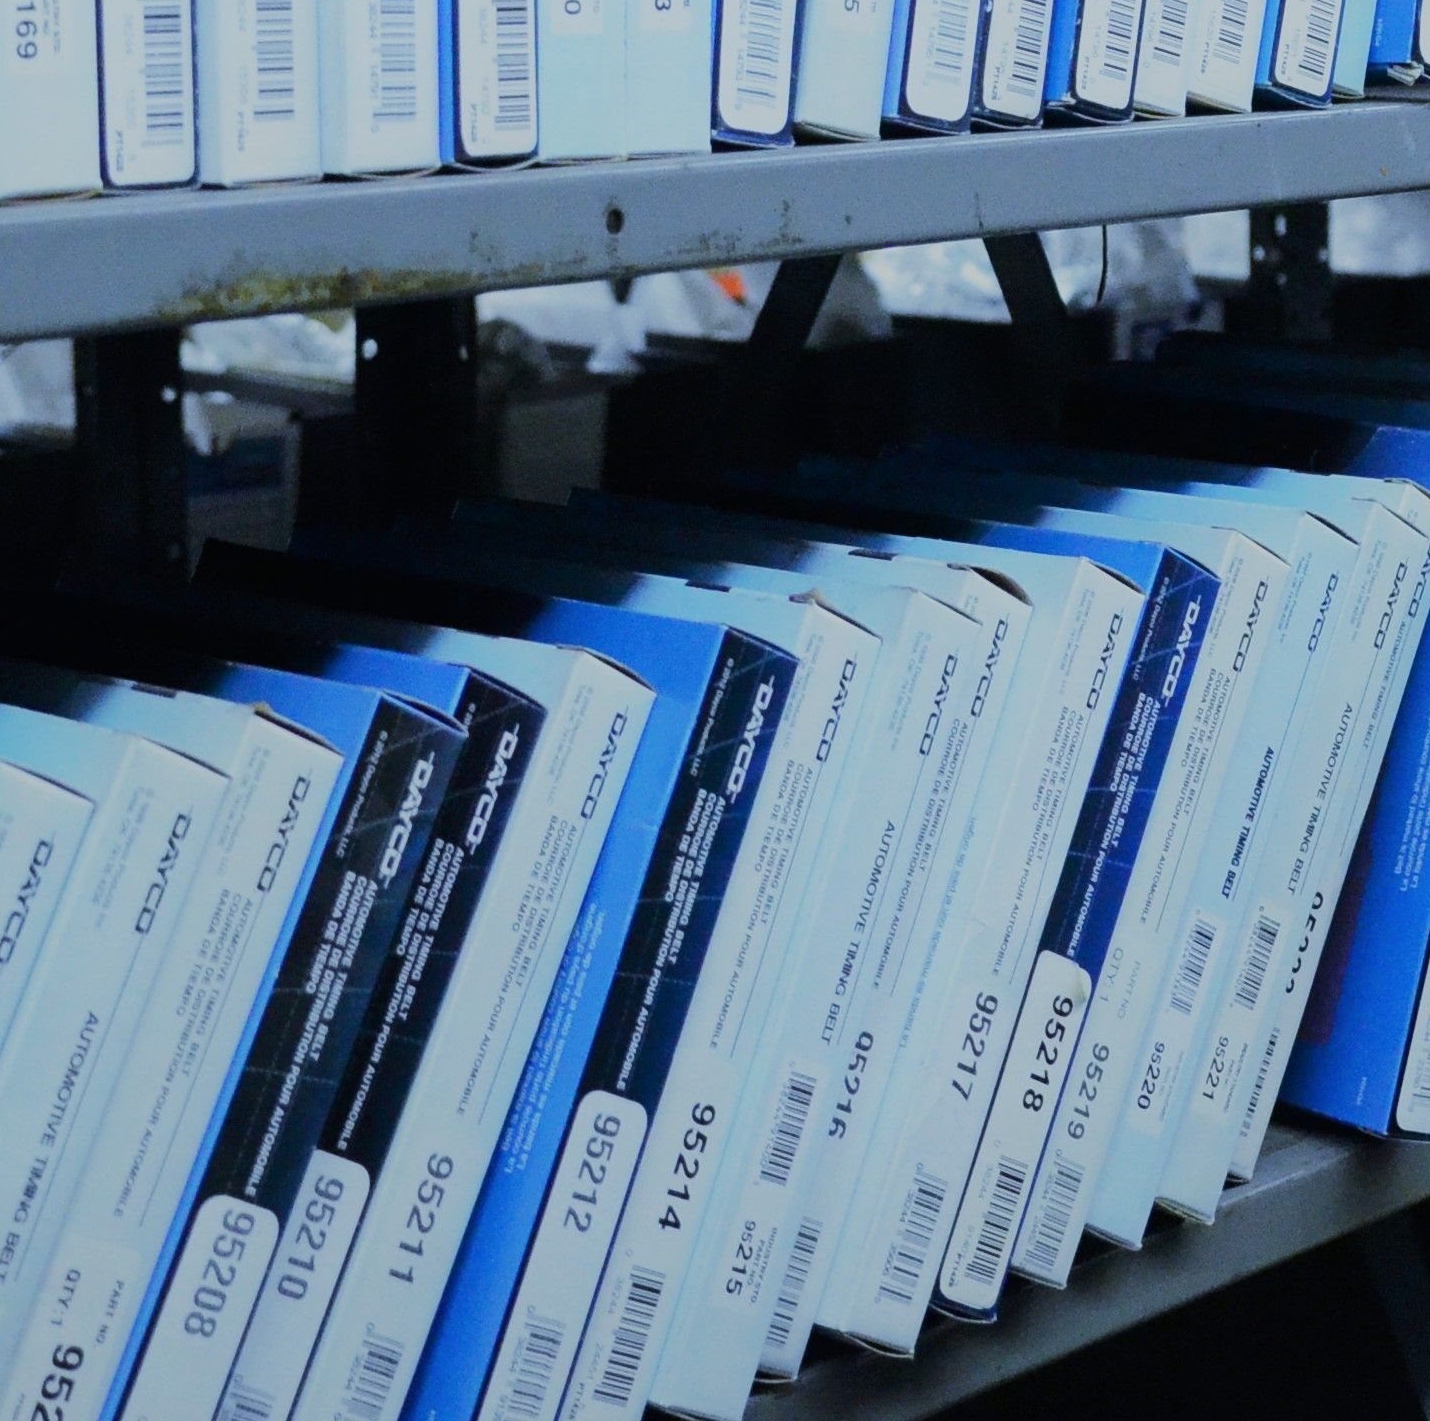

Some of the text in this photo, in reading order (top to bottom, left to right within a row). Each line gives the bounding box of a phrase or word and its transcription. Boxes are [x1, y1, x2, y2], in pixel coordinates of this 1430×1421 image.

[1161, 601, 1202, 698] DAYCO
[1232, 580, 1270, 674] DAYCO
[1373, 560, 1409, 650] DAYCO
[814, 658, 858, 763] DAYCO
[917, 652, 959, 757] DAYCO
[969, 617, 1010, 719] DAYCO
[1085, 612, 1124, 711] DAYCO
[464, 728, 519, 848] DAYCO
[580, 712, 628, 820] DAYCO
[726, 682, 773, 798] DAYCO
[380, 757, 436, 880] DAYCO
[820, 820, 895, 1046] AUTOMOTIVE TIMING BELT
[1124, 961, 1143, 995] PART
[948, 991, 1000, 1101] 95217
[1020, 995, 1075, 1113] 95218
[1065, 1041, 1111, 1142] 95219
[1136, 1041, 1167, 1110] 95220
[1200, 1036, 1230, 1101] 95221
[386, 1151, 456, 1284] 95211
[560, 1113, 623, 1234] 95212
[657, 1102, 718, 1230] 95214
[180, 1207, 257, 1339] 95208
[276, 1177, 347, 1300] 95210
[724, 1220, 757, 1296] 95215
[103, 1278, 126, 1318] PART
